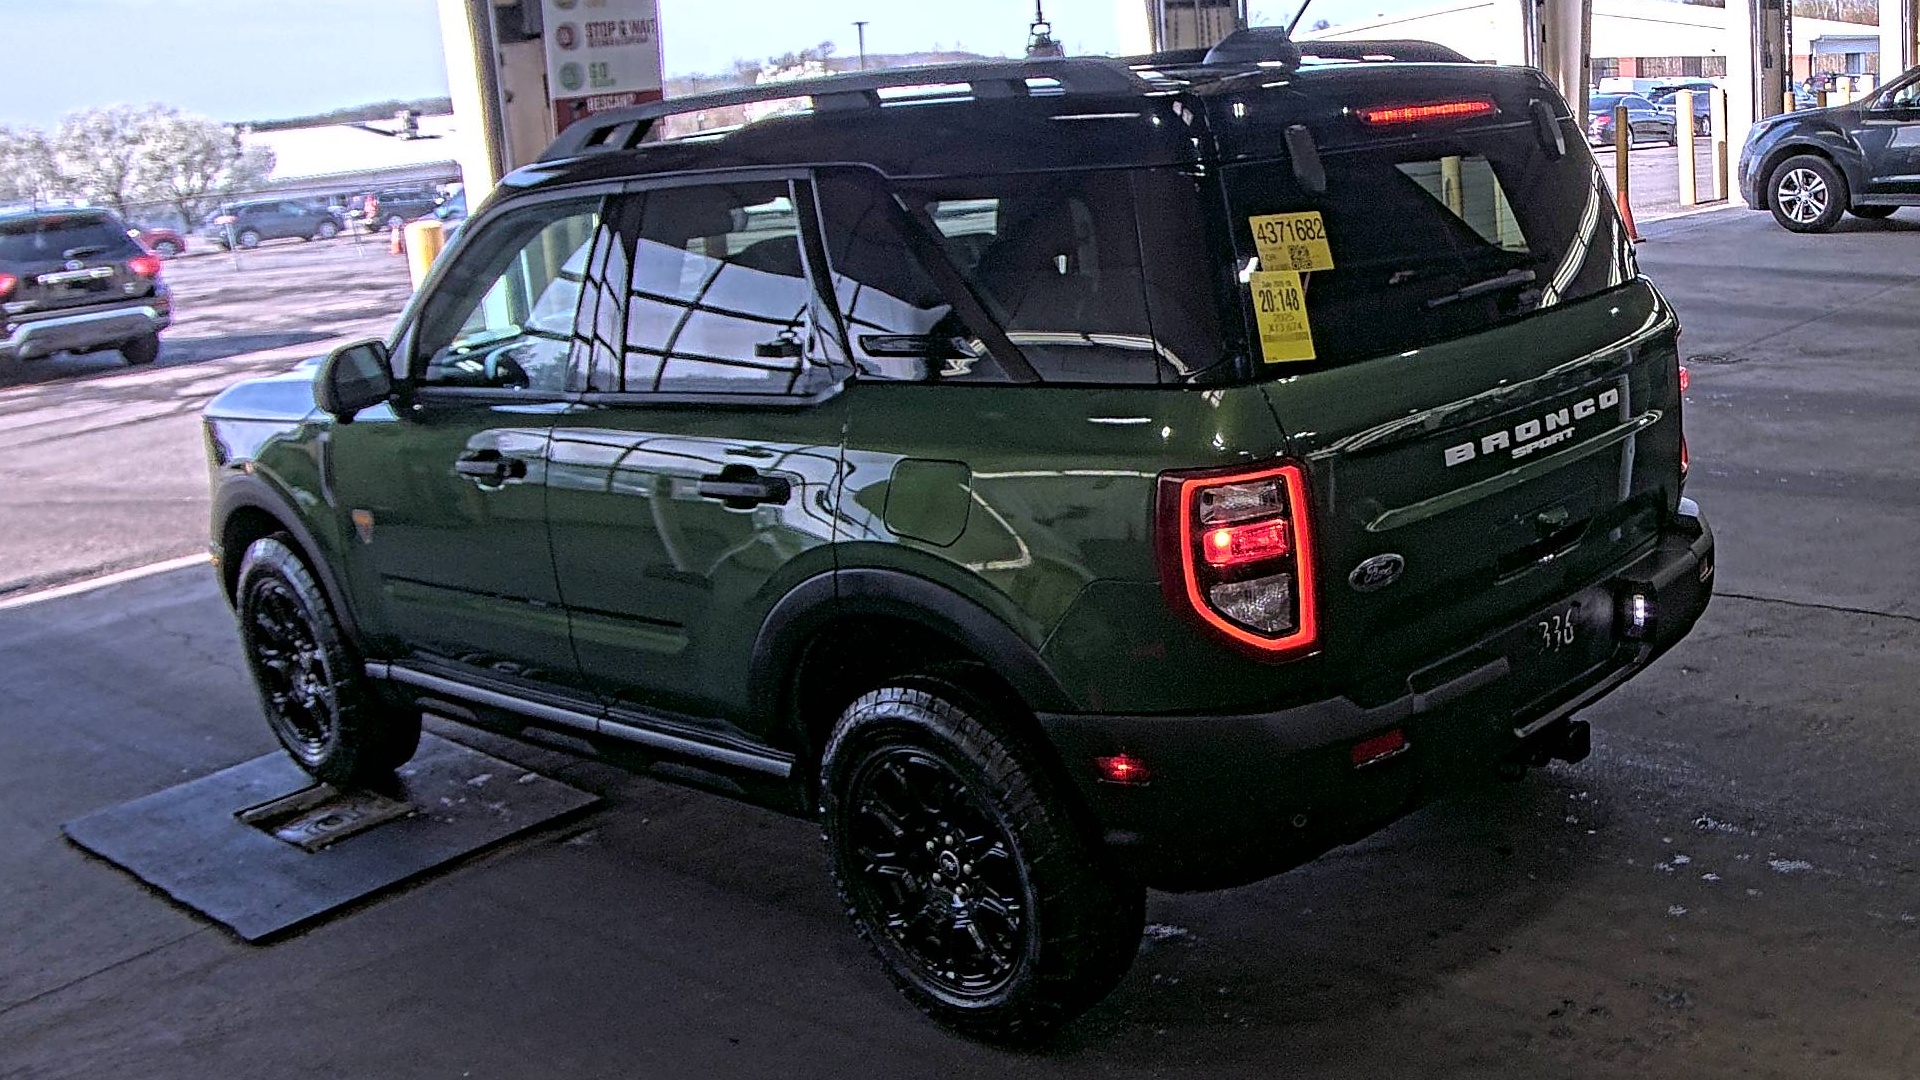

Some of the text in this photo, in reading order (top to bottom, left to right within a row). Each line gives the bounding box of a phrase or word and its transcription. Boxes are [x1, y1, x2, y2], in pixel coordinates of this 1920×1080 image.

[585, 21, 616, 38] STOP
[1257, 217, 1325, 245] 4371682
[1258, 287, 1300, 313] 20:148
[1444, 388, 1619, 467] BRONCO
[1510, 427, 1576, 459] SPORT
